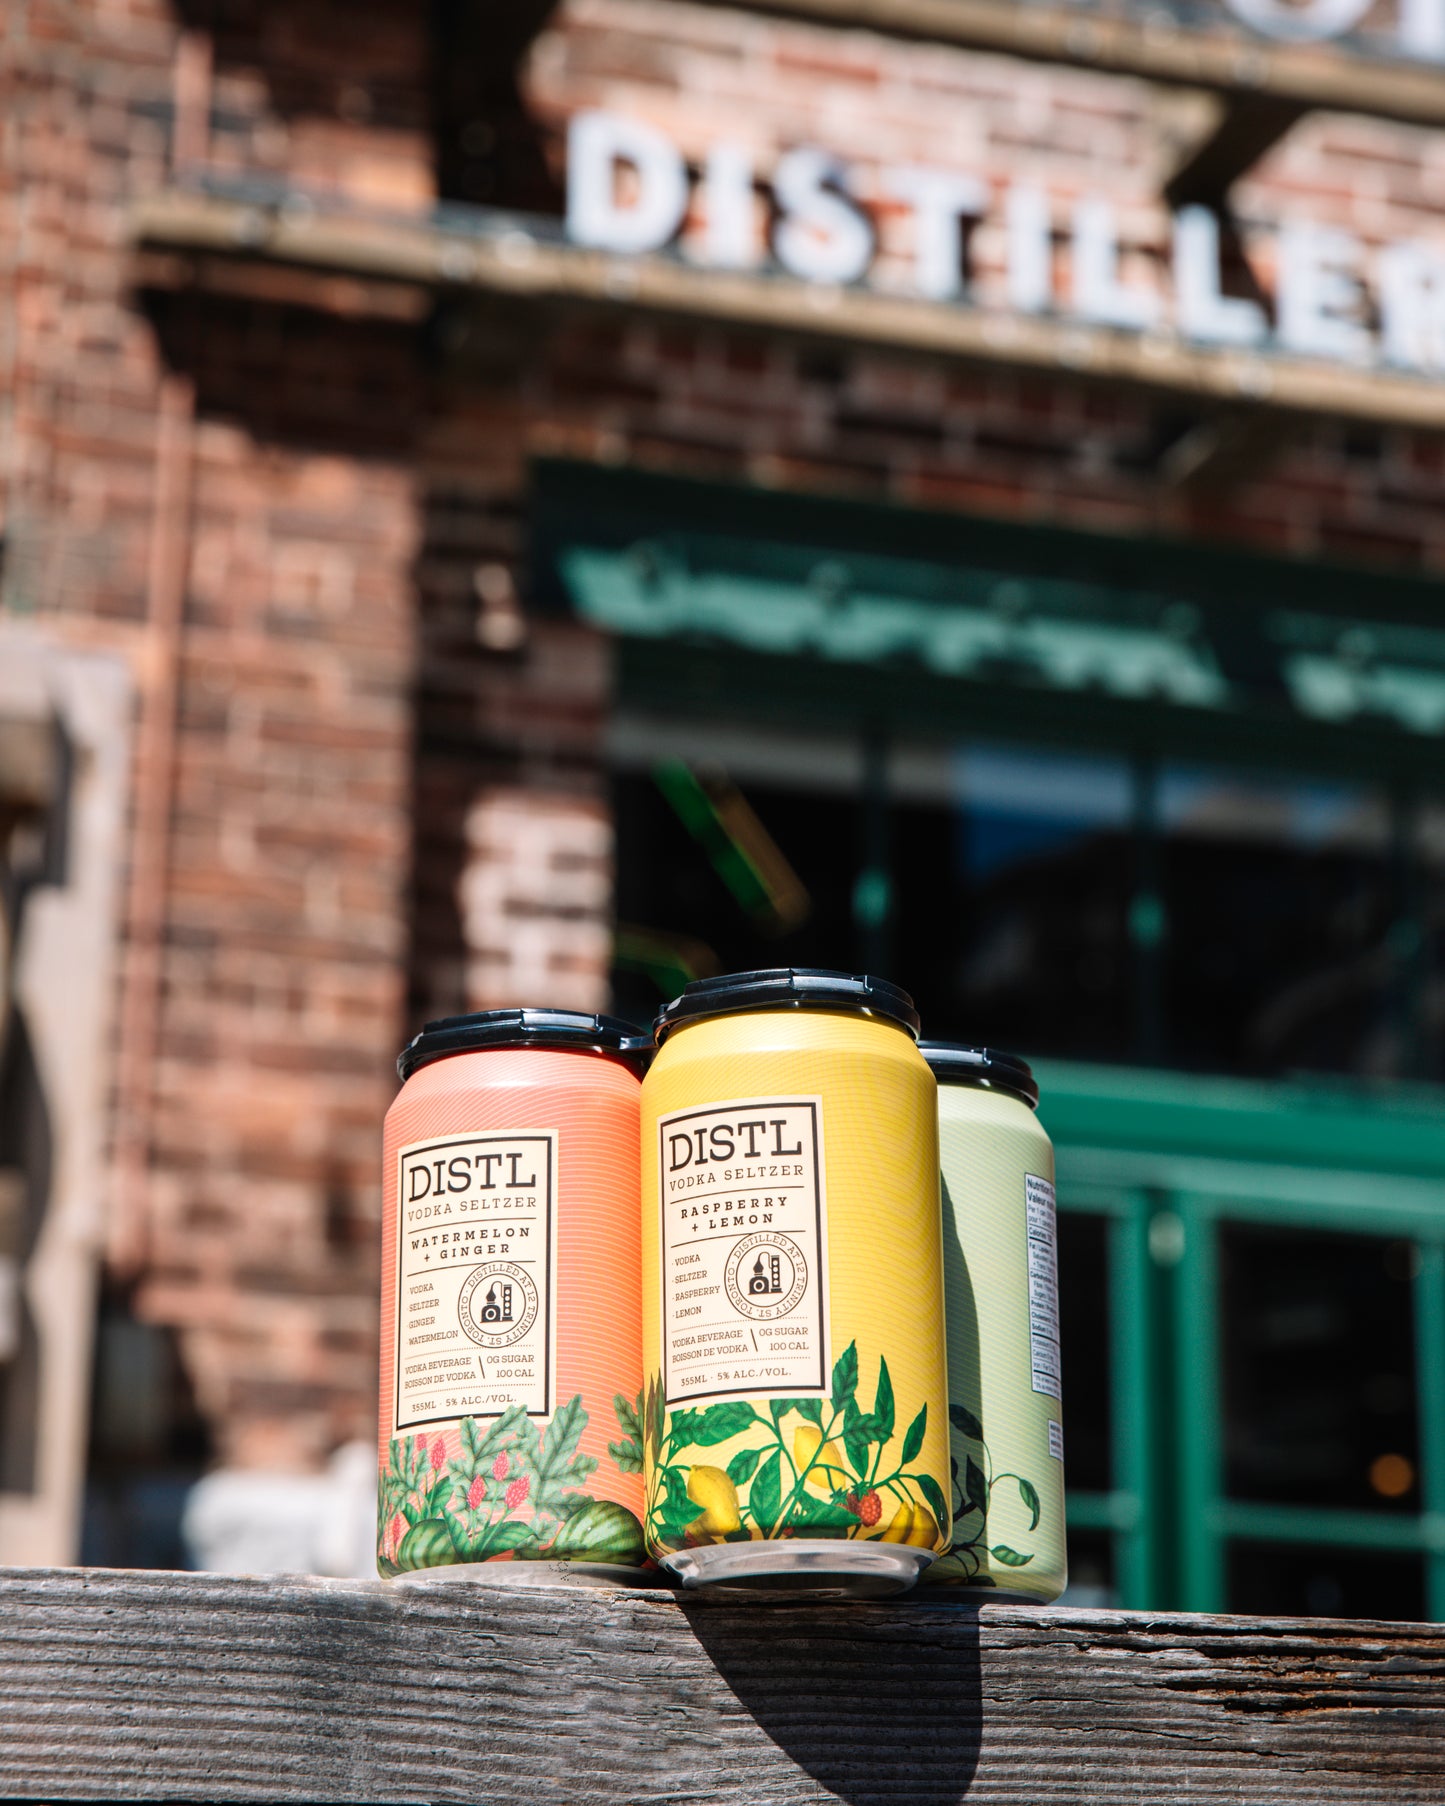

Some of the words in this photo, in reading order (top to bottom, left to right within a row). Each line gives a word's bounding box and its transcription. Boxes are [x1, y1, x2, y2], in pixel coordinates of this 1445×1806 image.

[669, 1120, 802, 1172] DISTL
[408, 1153, 536, 1202] DISTL
[669, 1172, 716, 1192] VODKA
[724, 1165, 804, 1181] SELTZER
[408, 1203, 452, 1222] VODKA
[459, 1196, 537, 1212] SELTZER
[681, 1196, 788, 1219] RASPBERRY
[709, 1213, 774, 1229] LEMON
[411, 1227, 530, 1250] WATERMELON
[733, 1233, 787, 1259] DISTILLED
[440, 1243, 509, 1260] GINGER
[787, 1246, 801, 1259] AT
[674, 1254, 701, 1267] VODKA
[796, 1261, 805, 1273] 12
[467, 1263, 520, 1288] DISTILLED
[519, 1276, 532, 1289] AT
[674, 1270, 708, 1284] SELTZER
[409, 1282, 434, 1295] VODKA
[527, 1291, 536, 1302] 12
[675, 1285, 721, 1302] RASPBERRY
[727, 1267, 753, 1315] TORONTO
[776, 1277, 805, 1315] TRINITY
[408, 1298, 440, 1312] SELTZER
[675, 1306, 702, 1319] LEMON
[408, 1316, 436, 1329] GINGER
[461, 1296, 485, 1342] TORONTO
[505, 1305, 536, 1343] TRINITY
[408, 1330, 459, 1346] WATERMELON
[672, 1336, 696, 1348] VODKA
[697, 1329, 744, 1343] BEVERAGE
[774, 1327, 809, 1336] SUGAR
[672, 1349, 702, 1363] BOISSON
[703, 1348, 715, 1357] DE
[716, 1344, 749, 1355] VODKA
[770, 1342, 787, 1351] 100
[788, 1341, 809, 1350] CAL
[405, 1363, 427, 1375] VODKA
[428, 1357, 472, 1369] BEVERAGE
[501, 1354, 535, 1364] SUGAR
[404, 1376, 433, 1389] BOISSON
[434, 1374, 445, 1384] DE
[446, 1371, 477, 1382] VODKA
[496, 1369, 513, 1378] 100
[514, 1369, 535, 1378] CAL
[681, 1374, 708, 1387] 355ML
[717, 1370, 730, 1380] 5%
[445, 1398, 458, 1407] 5%
